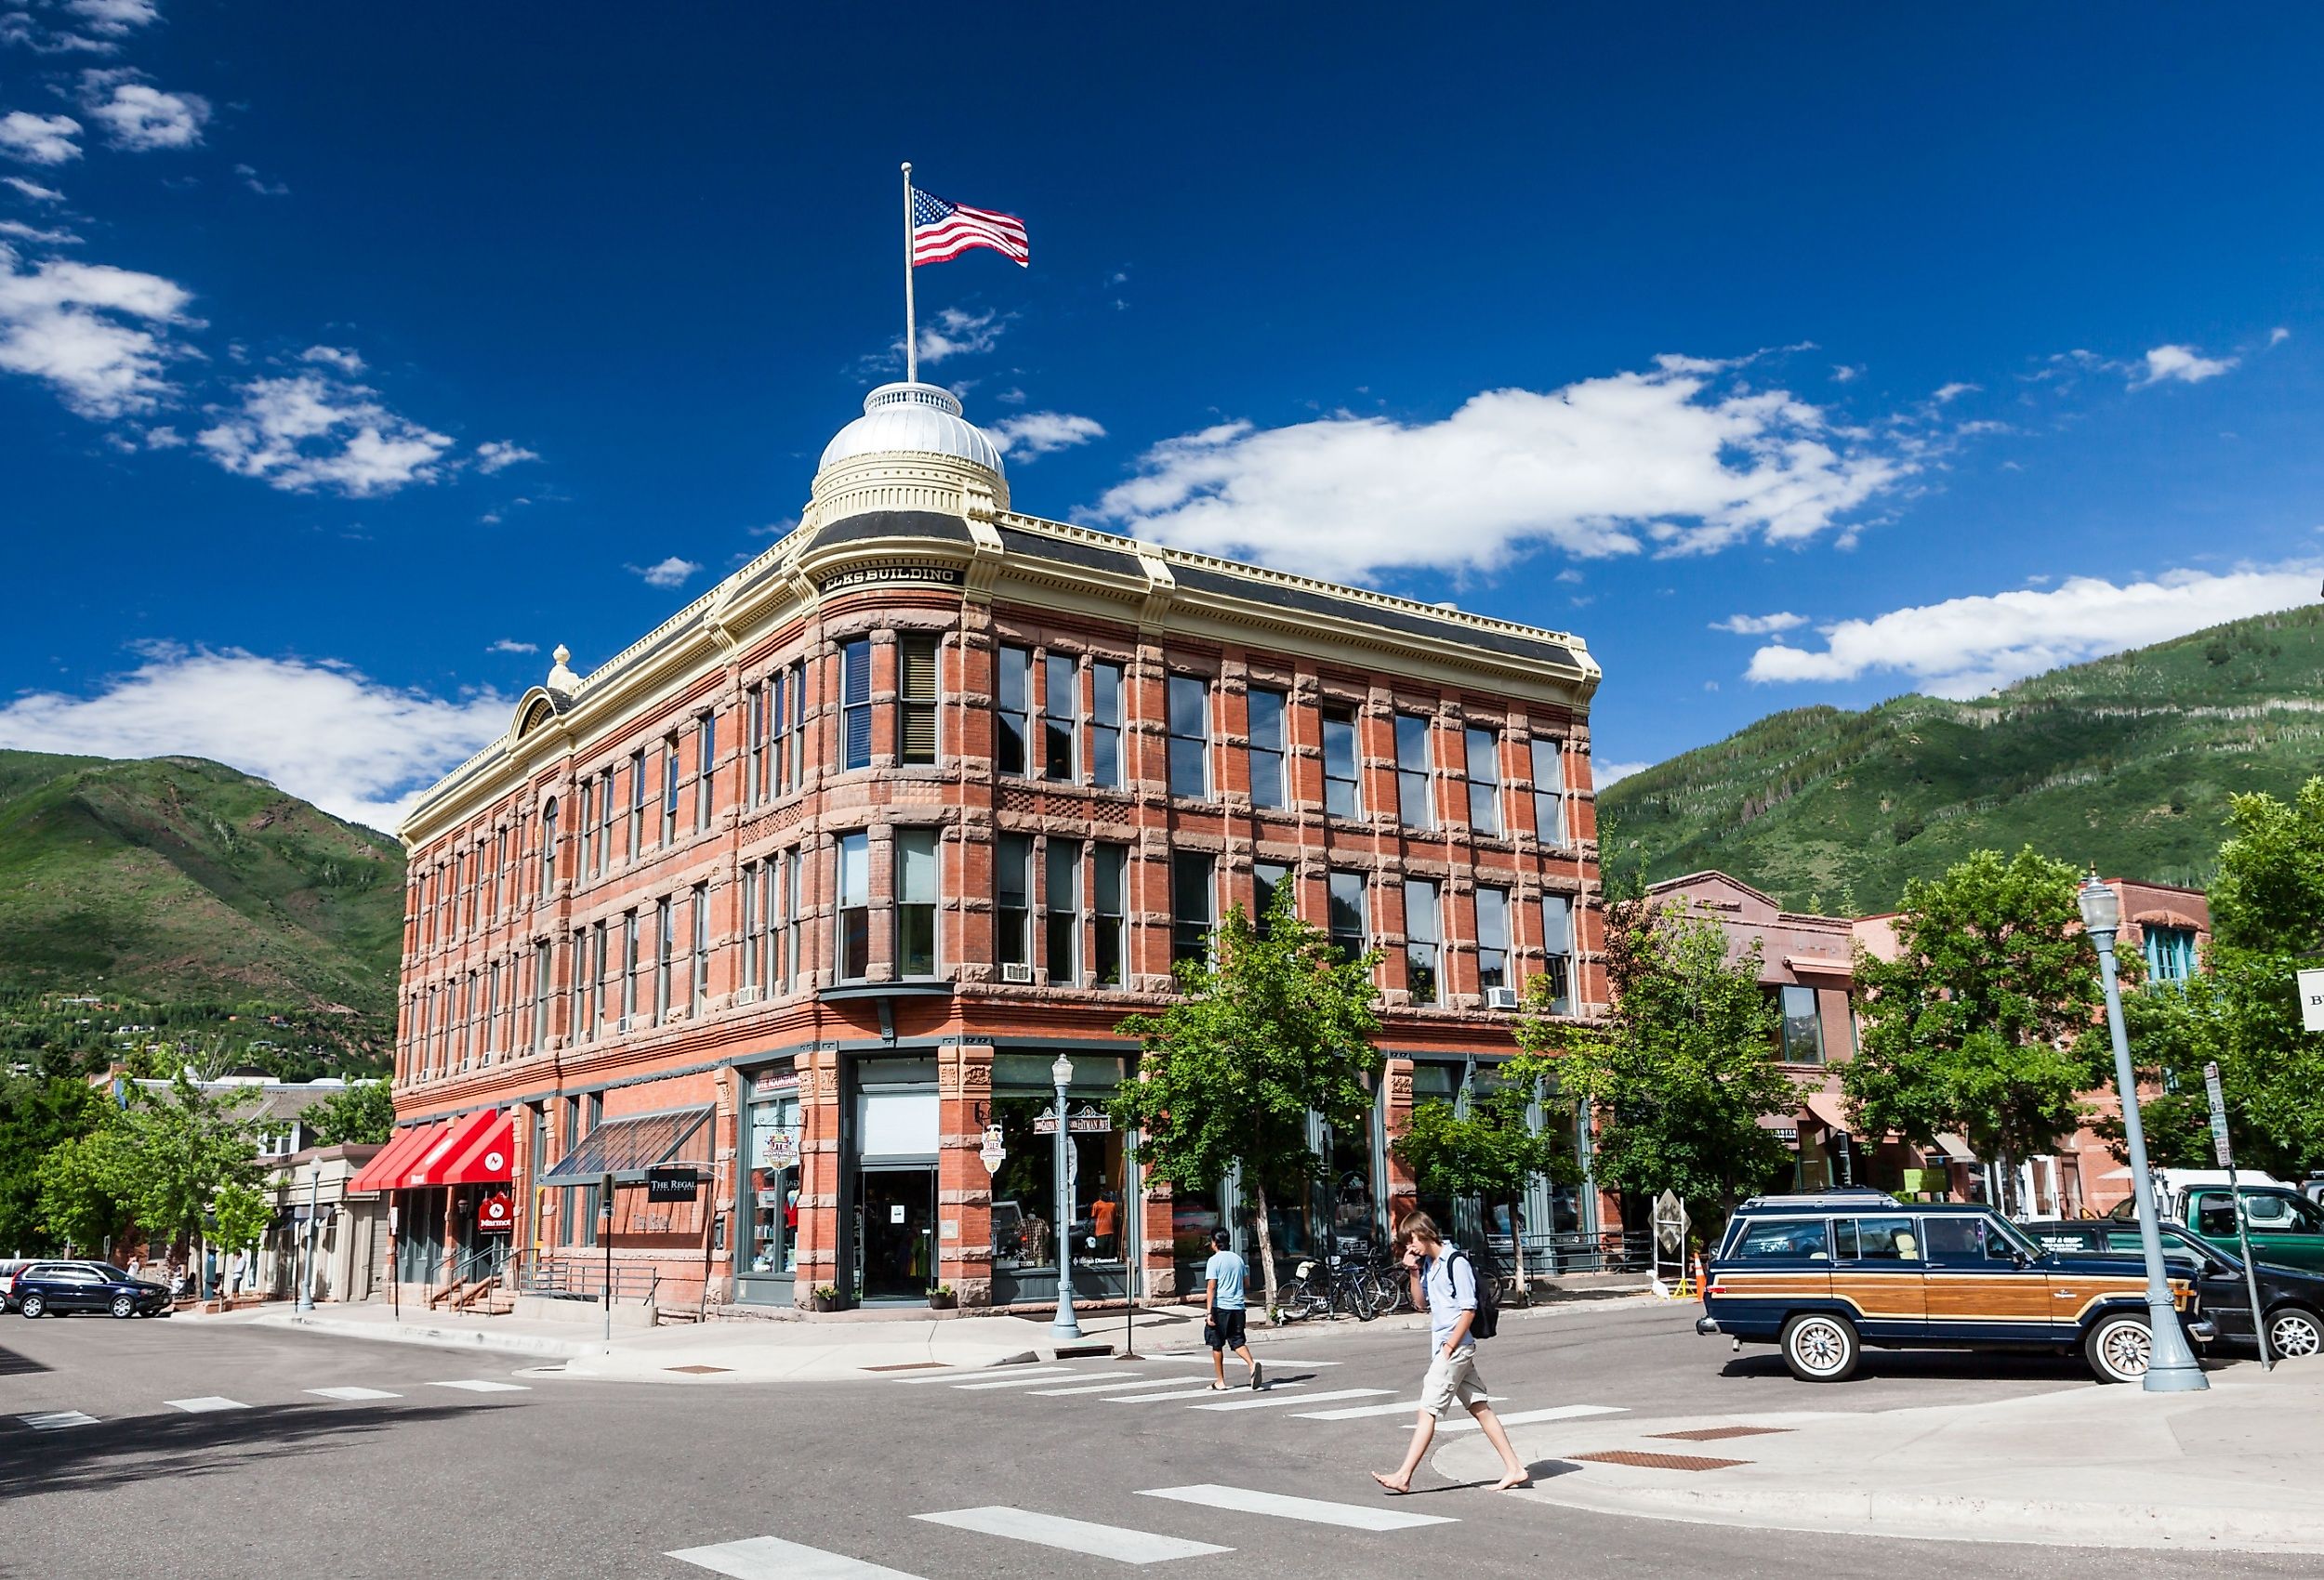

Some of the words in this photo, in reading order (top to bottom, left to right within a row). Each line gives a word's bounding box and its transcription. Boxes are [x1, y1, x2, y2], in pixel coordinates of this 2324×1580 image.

[825, 572, 864, 591] ELKS
[865, 568, 954, 581] BUILDING
[652, 1180, 668, 1189] THE
[671, 1180, 696, 1189] REGAL
[481, 1218, 511, 1227] Marmot
